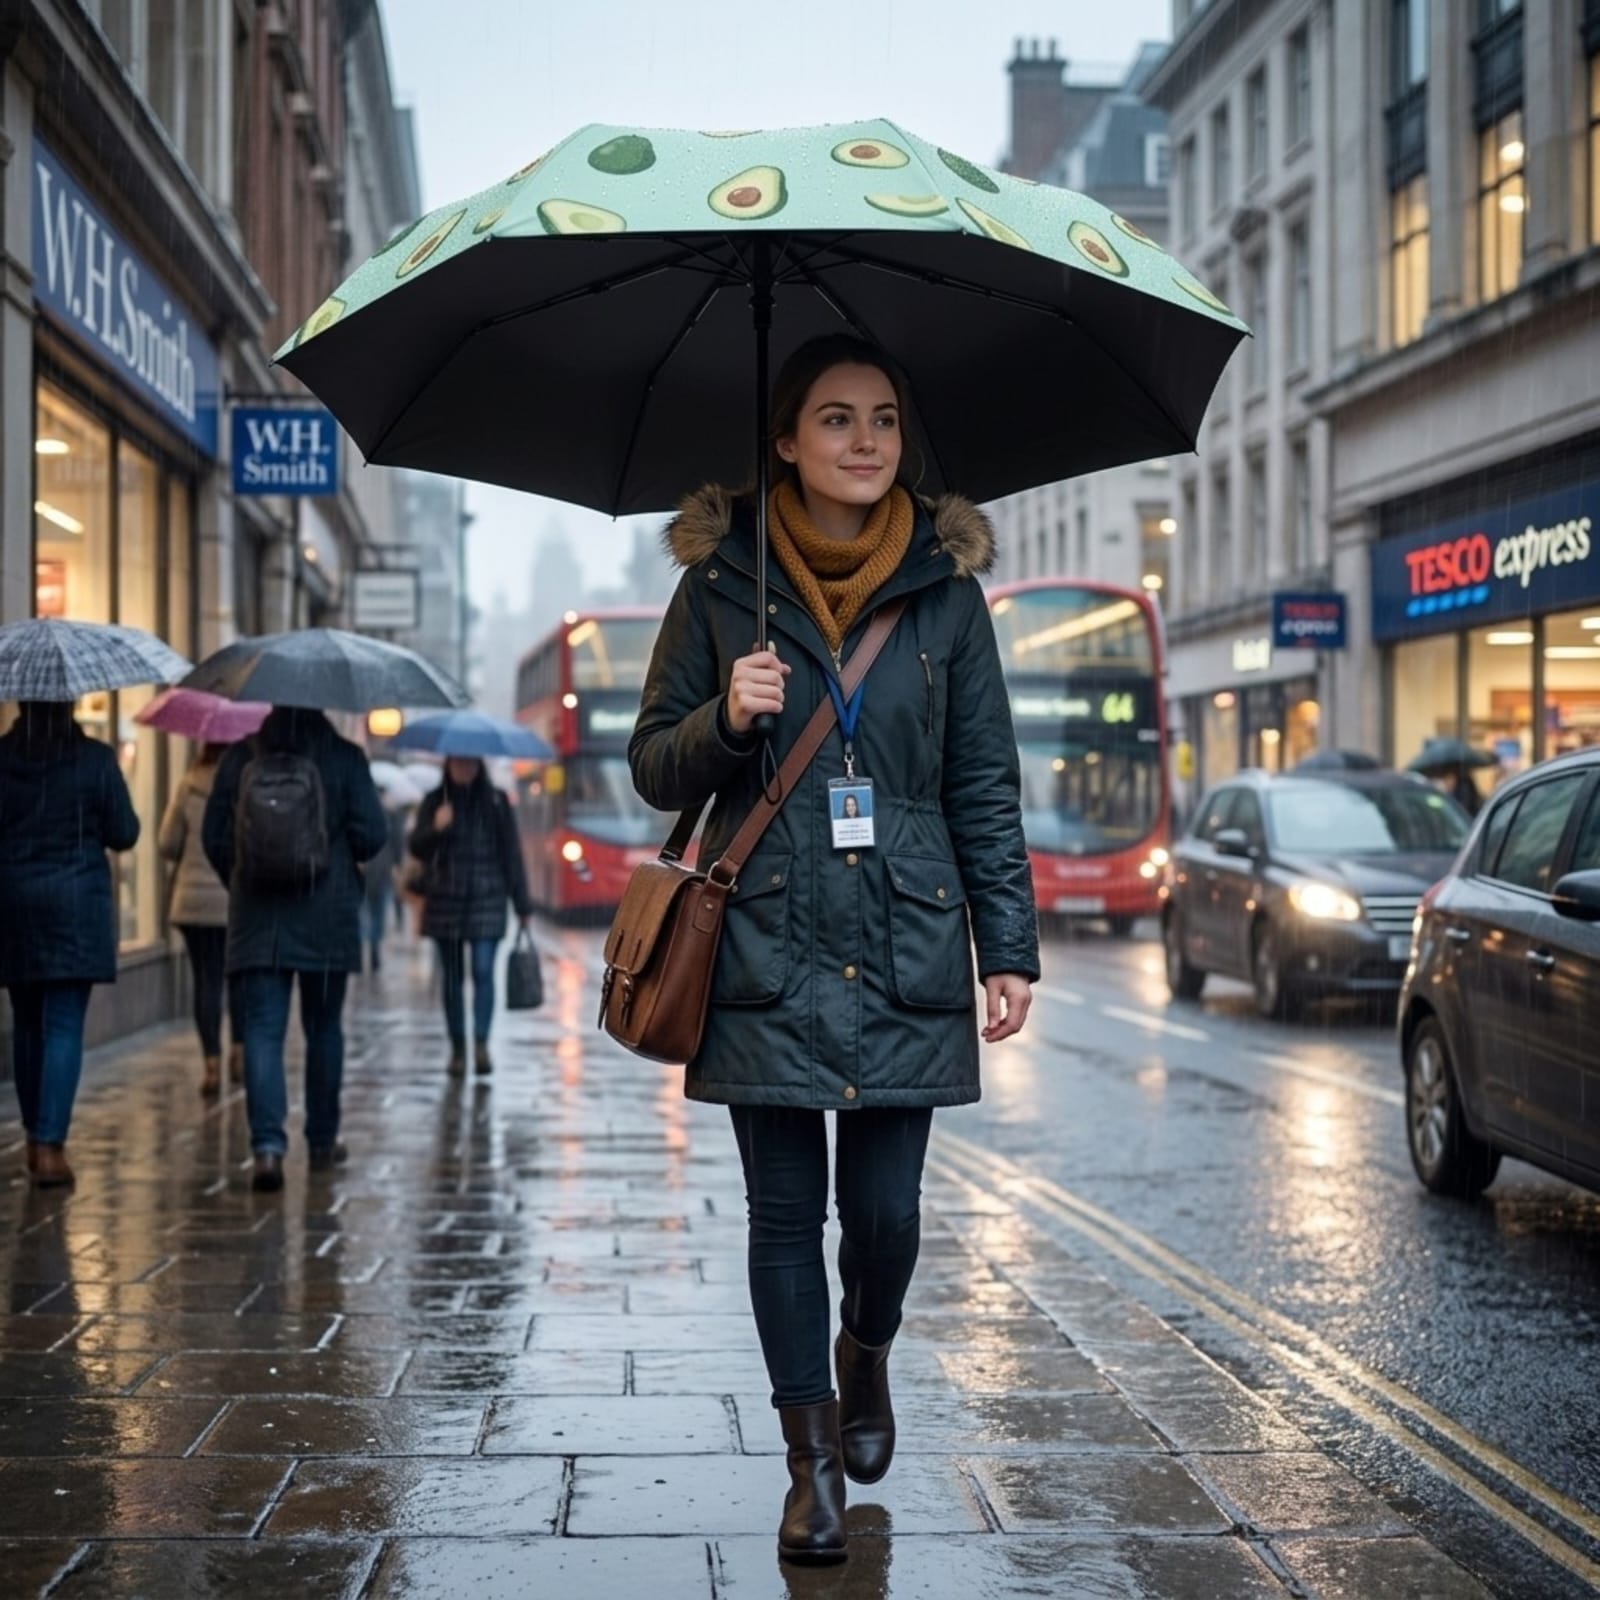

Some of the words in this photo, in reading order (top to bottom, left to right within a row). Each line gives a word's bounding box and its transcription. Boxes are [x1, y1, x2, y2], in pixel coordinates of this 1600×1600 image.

[246, 419, 331, 454] W.H.
[243, 454, 328, 485] Smith
[1405, 533, 1491, 596] TESCO
[1494, 517, 1592, 589] express
